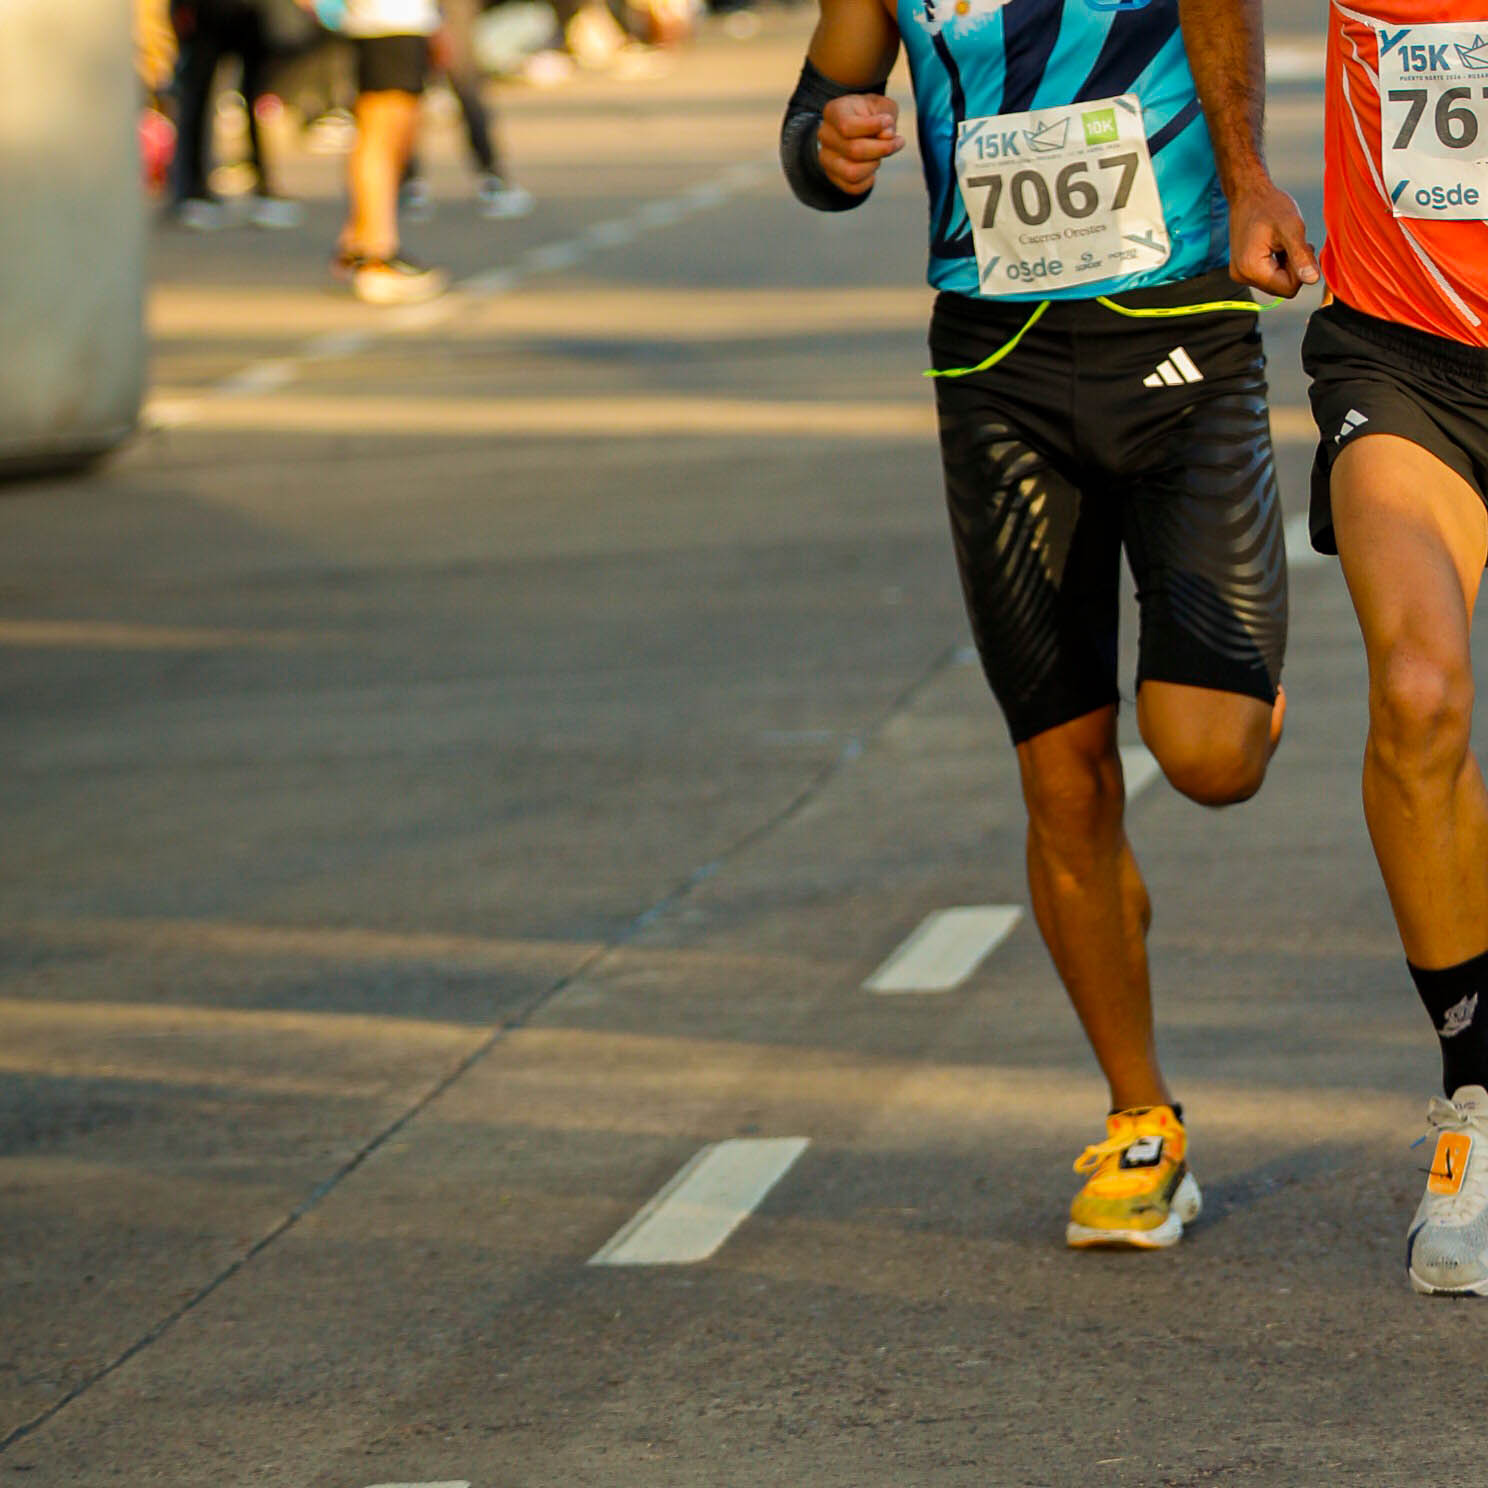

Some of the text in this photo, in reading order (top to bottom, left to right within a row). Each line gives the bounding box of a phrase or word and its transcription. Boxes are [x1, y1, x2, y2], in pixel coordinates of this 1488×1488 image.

[1398, 44, 1451, 73] 15K
[1086, 119, 1115, 135] 10K
[975, 130, 1020, 160] 15K
[966, 152, 1139, 229] 7067
[1415, 183, 1479, 209] osde
[1006, 257, 1063, 282] osde
